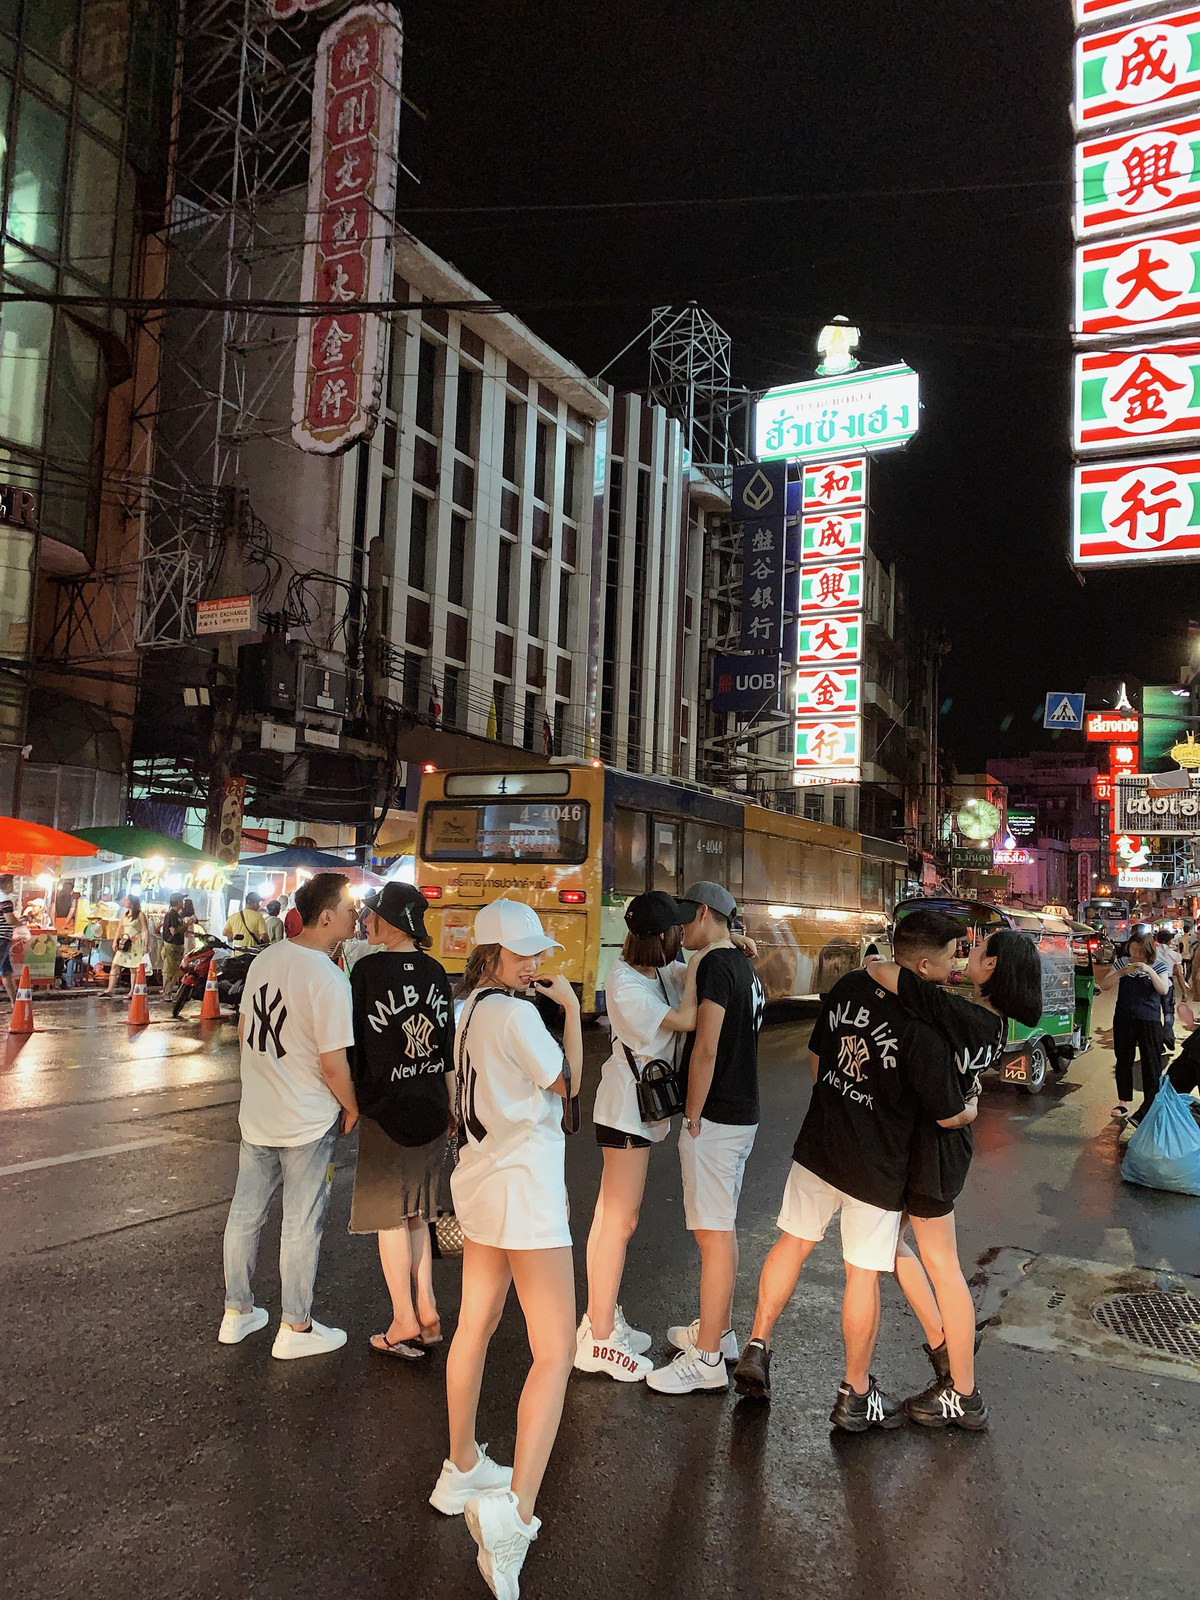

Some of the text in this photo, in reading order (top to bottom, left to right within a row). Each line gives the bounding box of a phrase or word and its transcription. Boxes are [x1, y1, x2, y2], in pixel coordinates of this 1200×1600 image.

[1109, 35, 1188, 542] 成興大金行
[747, 527, 776, 640] 盤谷銀行
[219, 609, 248, 618] EXCHANGE
[810, 470, 849, 760] 和成興大金行
[736, 674, 776, 691] UOB
[520, 805, 581, 822] 4-4046
[696, 838, 723, 854] 4-4046
[1044, 906, 1062, 915] TAXI
[367, 984, 419, 1033] MLB
[870, 1021, 899, 1070] like
[390, 1063, 417, 1082] New
[842, 1080, 874, 1111] York
[592, 1344, 640, 1375] BOSTON
[865, 1389, 886, 1422] NY
[938, 1388, 966, 1419] NY
